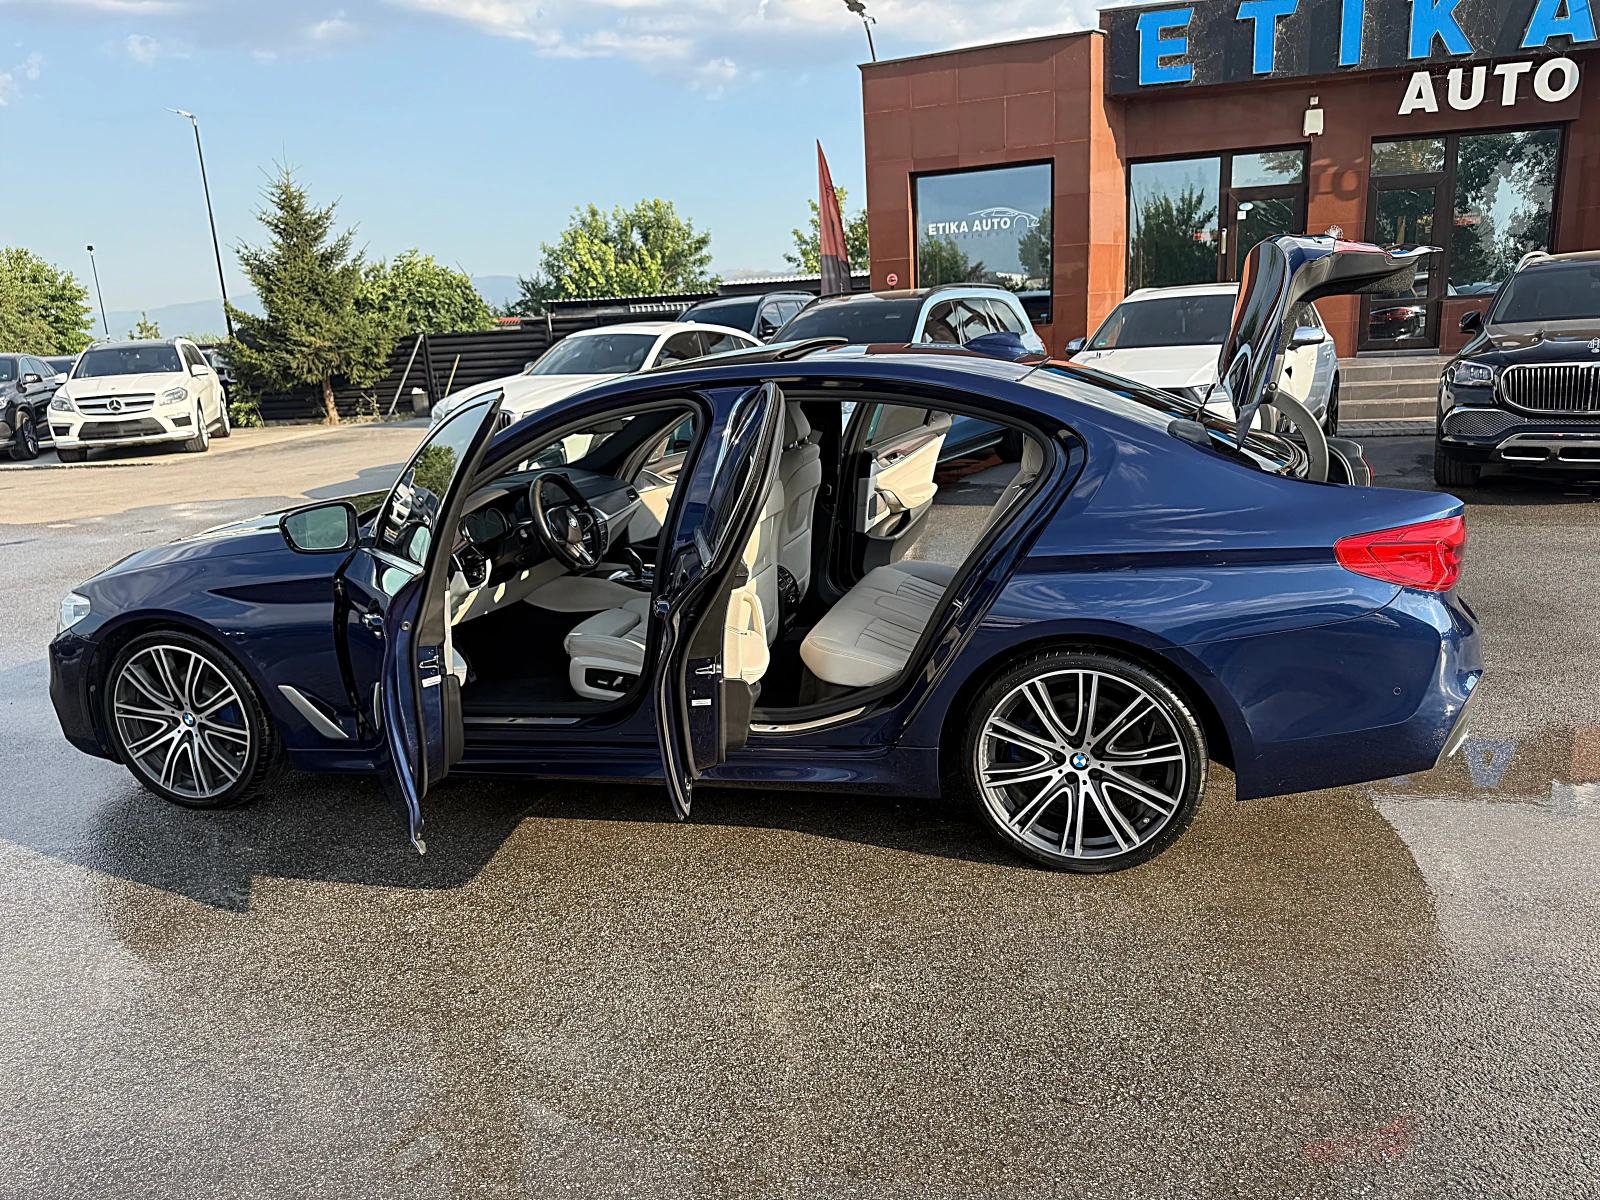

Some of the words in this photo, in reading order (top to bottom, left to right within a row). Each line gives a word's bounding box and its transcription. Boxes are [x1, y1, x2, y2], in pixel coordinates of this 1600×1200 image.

[1136, 0, 1598, 86] ETIKA
[1398, 57, 1581, 116] AUTO
[928, 221, 968, 235] ETIKA
[972, 217, 1011, 231] AUTO
